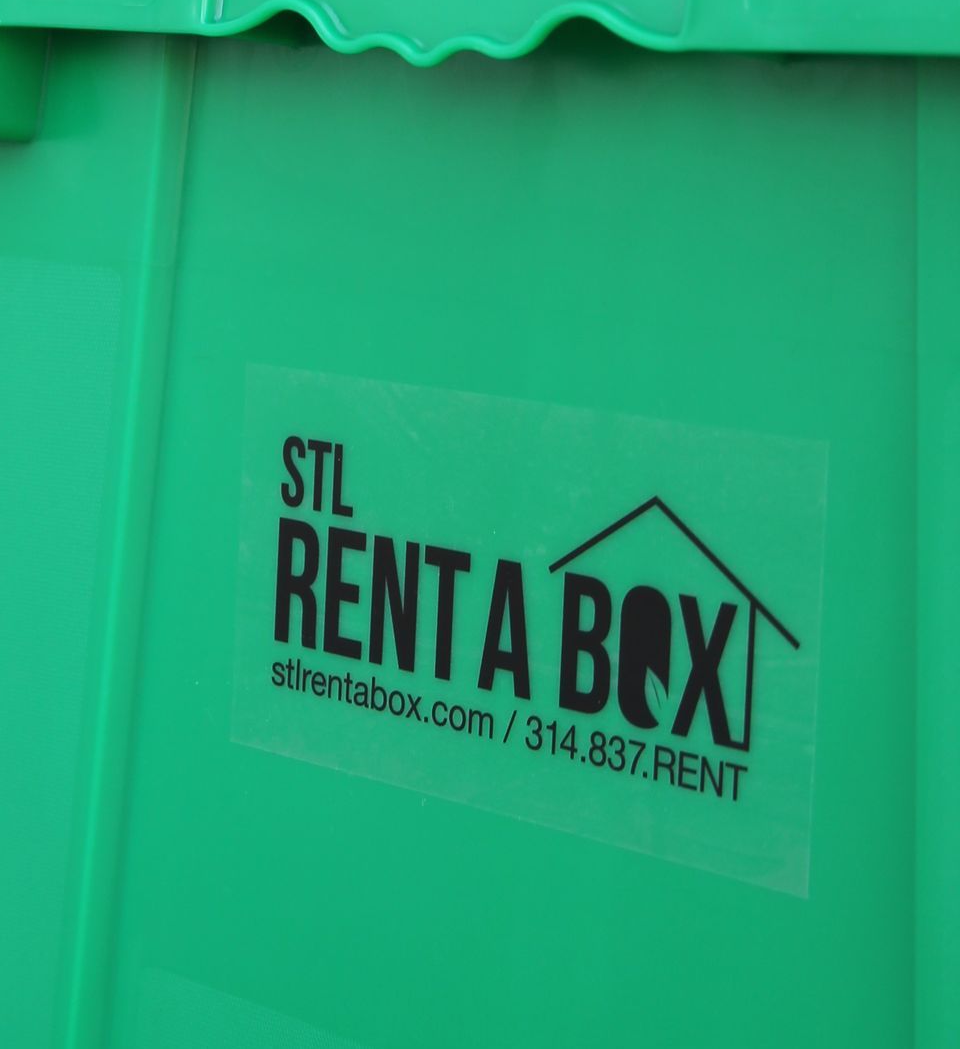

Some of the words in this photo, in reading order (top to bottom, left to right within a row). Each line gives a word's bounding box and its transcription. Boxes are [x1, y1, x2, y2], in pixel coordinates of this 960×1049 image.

[280, 435, 354, 518] STL
[273, 516, 472, 682] RENT
[477, 558, 531, 701] A
[558, 571, 739, 751] BOX
[271, 658, 495, 740] stlrentabox.com
[524, 714, 749, 802] 314.837.RENT
